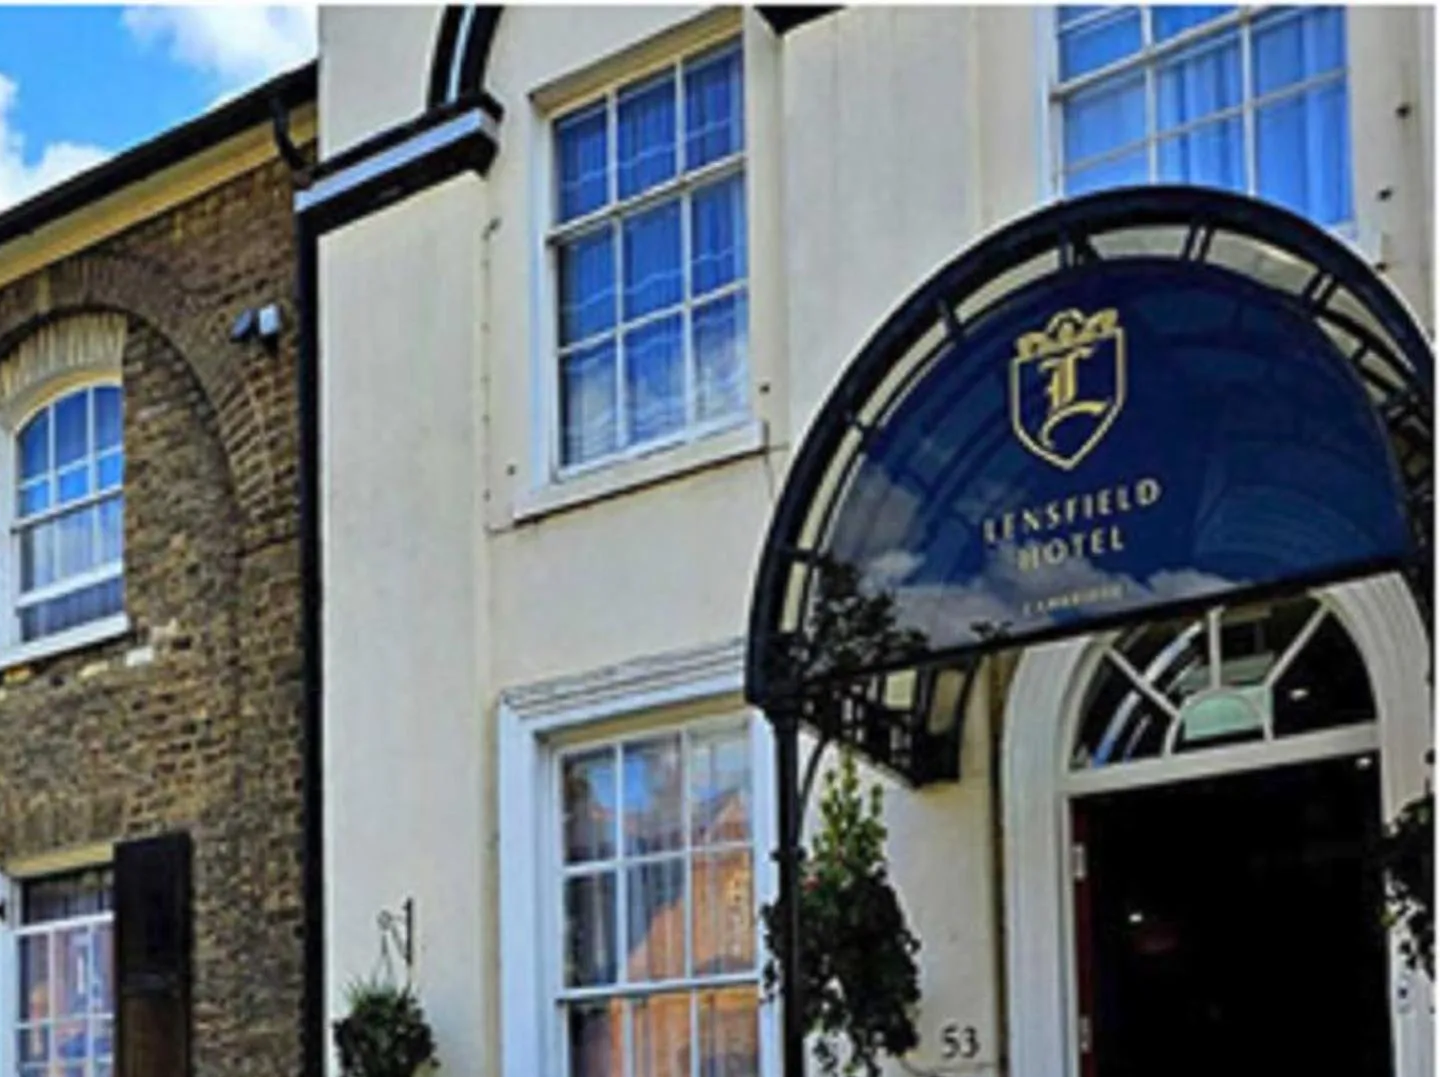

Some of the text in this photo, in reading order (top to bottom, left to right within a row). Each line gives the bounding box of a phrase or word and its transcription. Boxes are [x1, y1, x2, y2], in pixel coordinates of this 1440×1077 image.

[983, 478, 1161, 544] LENSFIELD
[1017, 526, 1125, 571] HOTEL
[941, 1024, 981, 1059] 53
